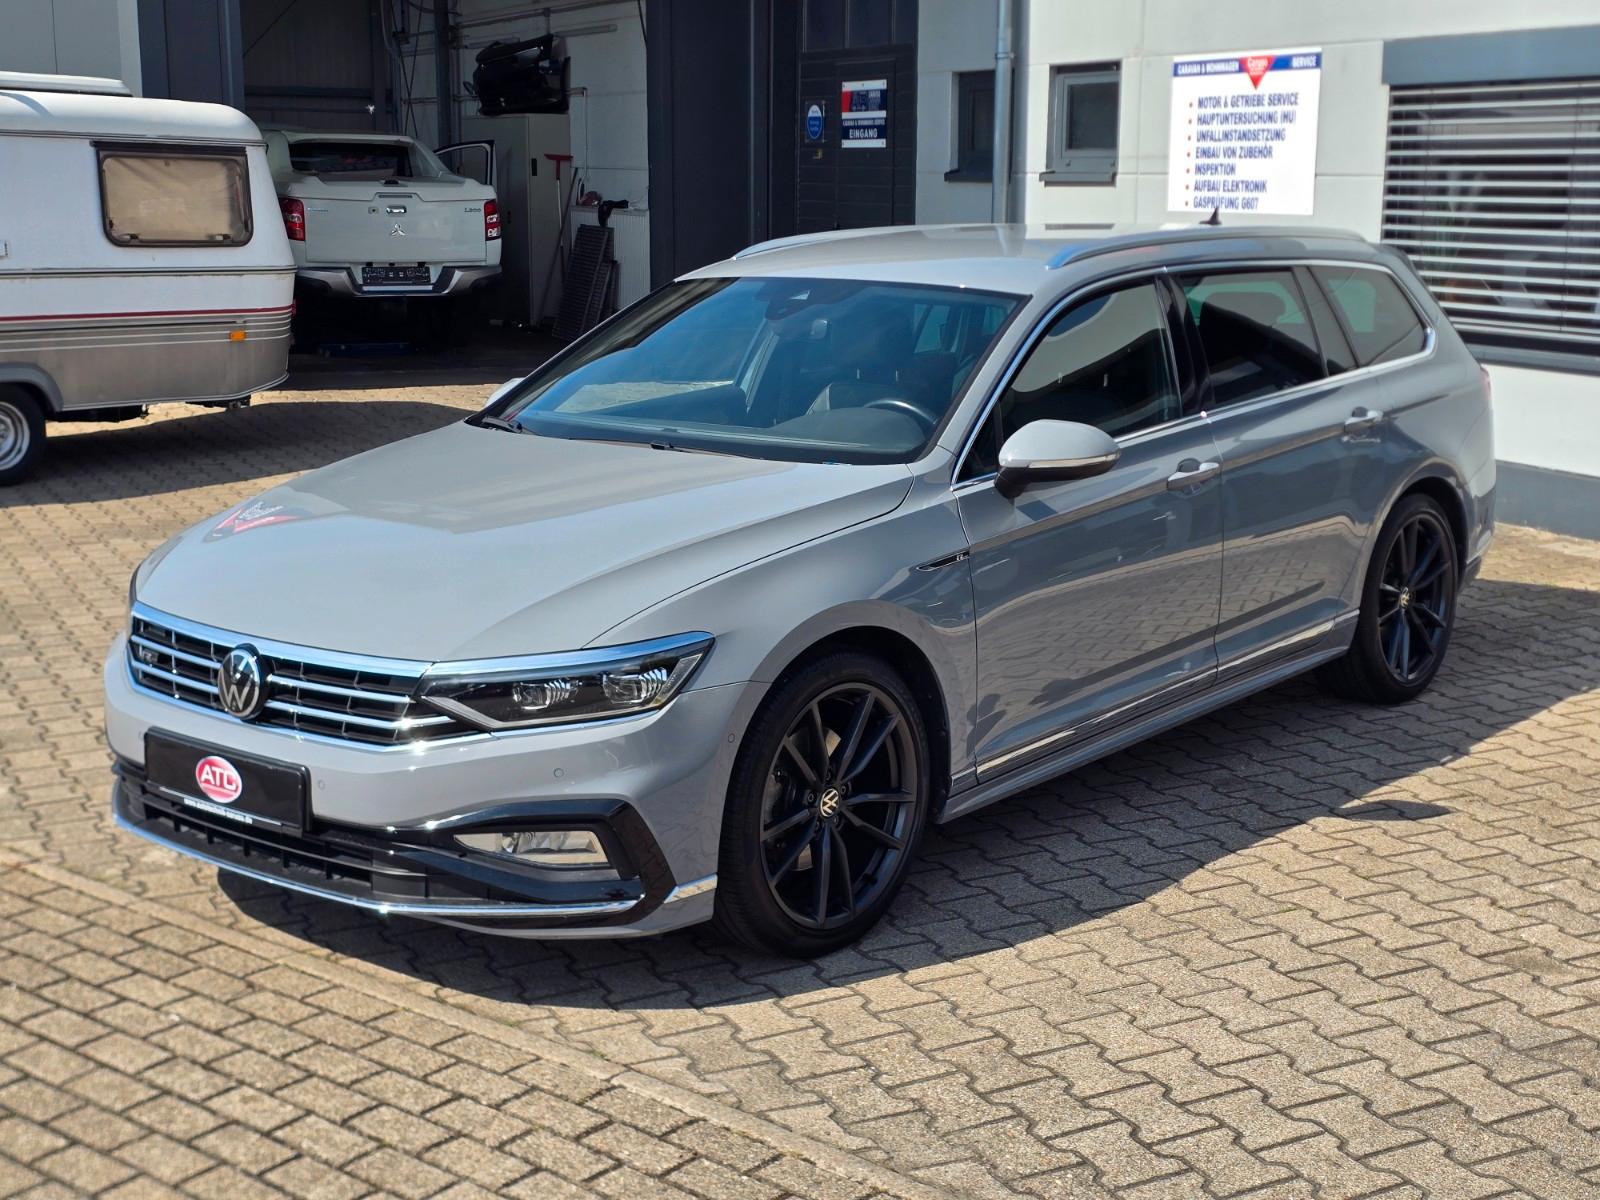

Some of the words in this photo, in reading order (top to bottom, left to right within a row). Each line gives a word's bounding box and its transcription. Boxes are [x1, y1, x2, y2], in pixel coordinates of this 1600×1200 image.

[1292, 56, 1317, 68] SERVICE
[1198, 96, 1222, 109] MOTOR
[1223, 96, 1229, 108] &
[1230, 94, 1265, 108] GETRIEBE
[1268, 92, 1299, 107] SERVICE
[1197, 111, 1279, 126] HAUPTUNTERSUCHUNG
[1280, 110, 1297, 124] (HU)
[849, 128, 878, 139] EINGANG
[1196, 128, 1286, 143] UNFALLINSTANDSETZUNG
[1195, 146, 1221, 159] EINBAU
[1222, 145, 1237, 159] VON
[1238, 144, 1274, 159] ZUBEHÖR
[1194, 163, 1236, 176] INSPEKTION
[1193, 179, 1221, 193] AUFBAU
[1222, 179, 1268, 193] ELEKTRONIK
[1193, 195, 1240, 209] GASPRÜFUNG
[1241, 196, 1259, 210] G607
[201, 764, 237, 791] ATC
